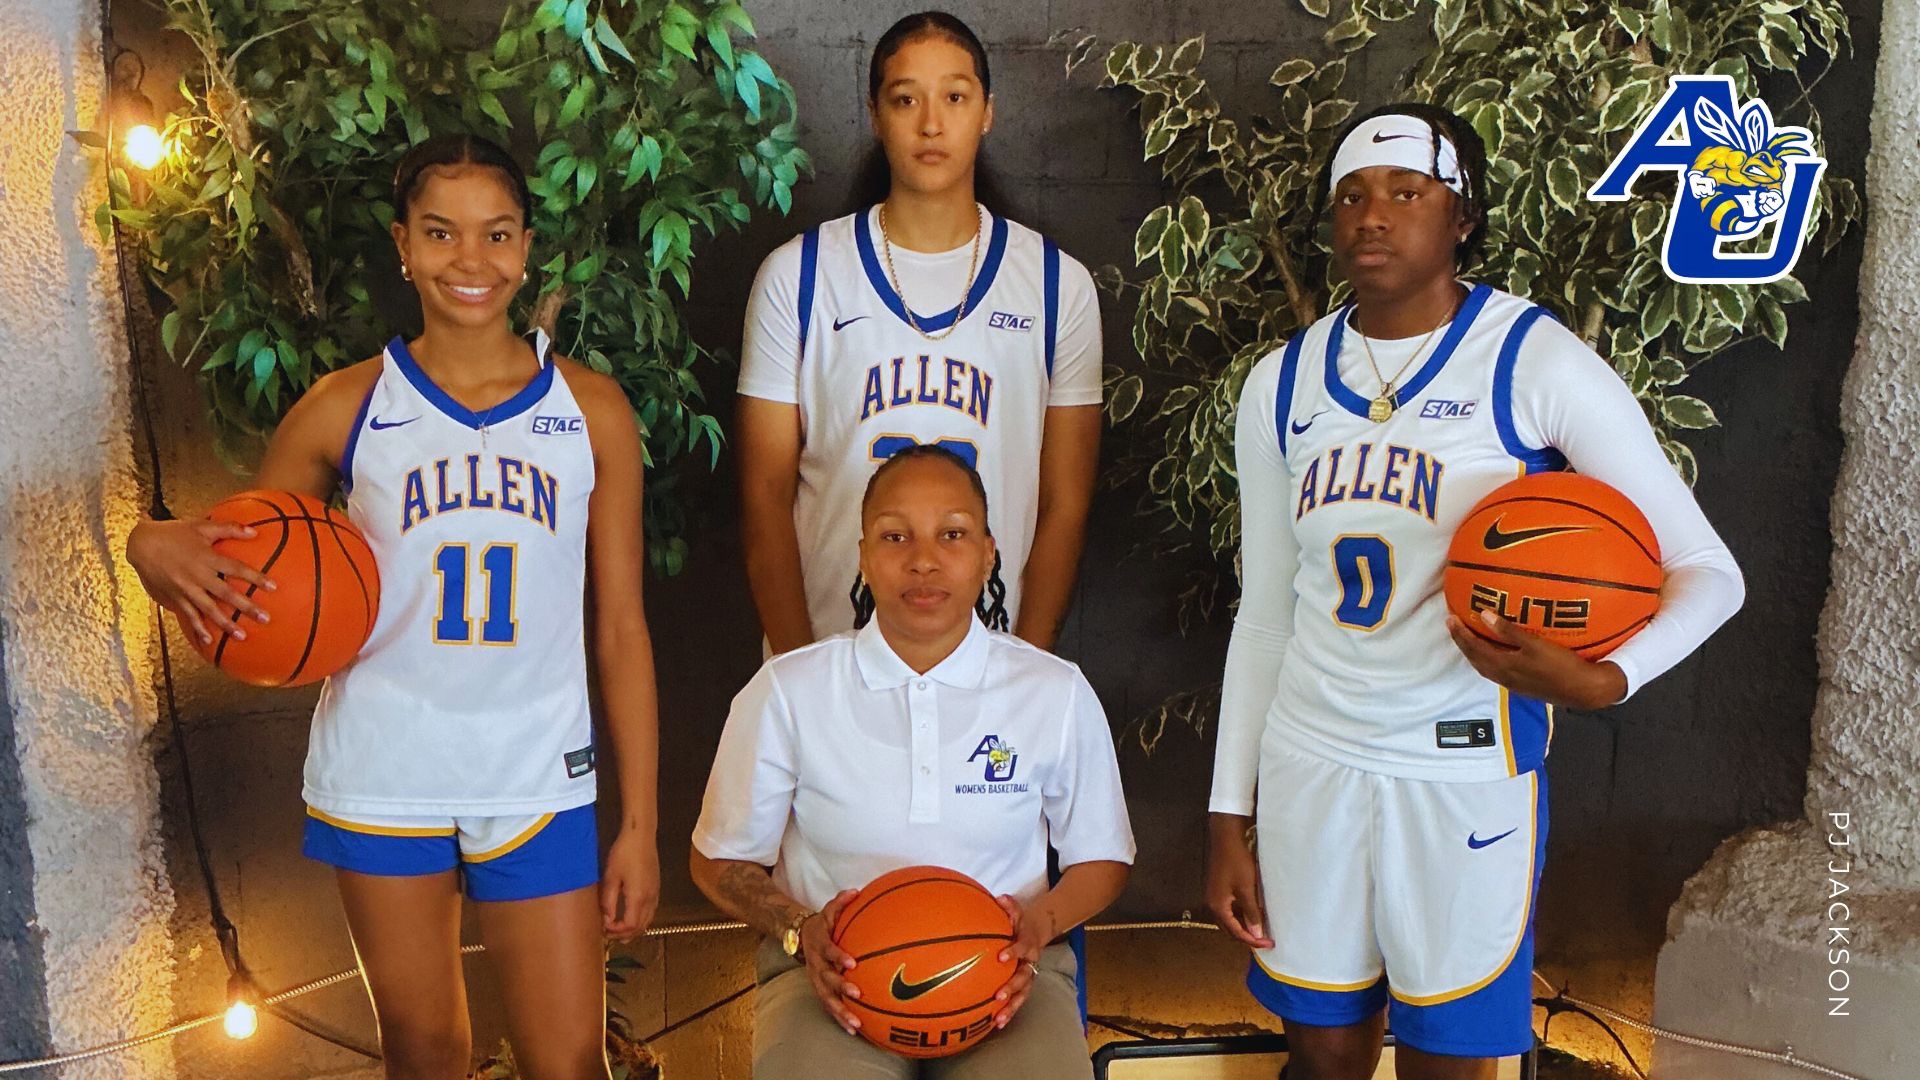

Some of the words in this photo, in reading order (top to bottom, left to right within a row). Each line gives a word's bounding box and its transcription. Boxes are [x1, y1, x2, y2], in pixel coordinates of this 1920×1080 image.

[860, 354, 993, 428] ALLEN
[401, 454, 559, 536] ALLEN
[1296, 443, 1445, 525] ALLEN
[432, 542, 519, 646] 11
[1330, 533, 1396, 632] 0
[1470, 583, 1590, 629] ELITE
[1477, 727, 1486, 739] S
[955, 784, 986, 794] WOMENS
[988, 783, 1029, 794] BASKETBALL
[889, 1012, 993, 1048] ELITE
